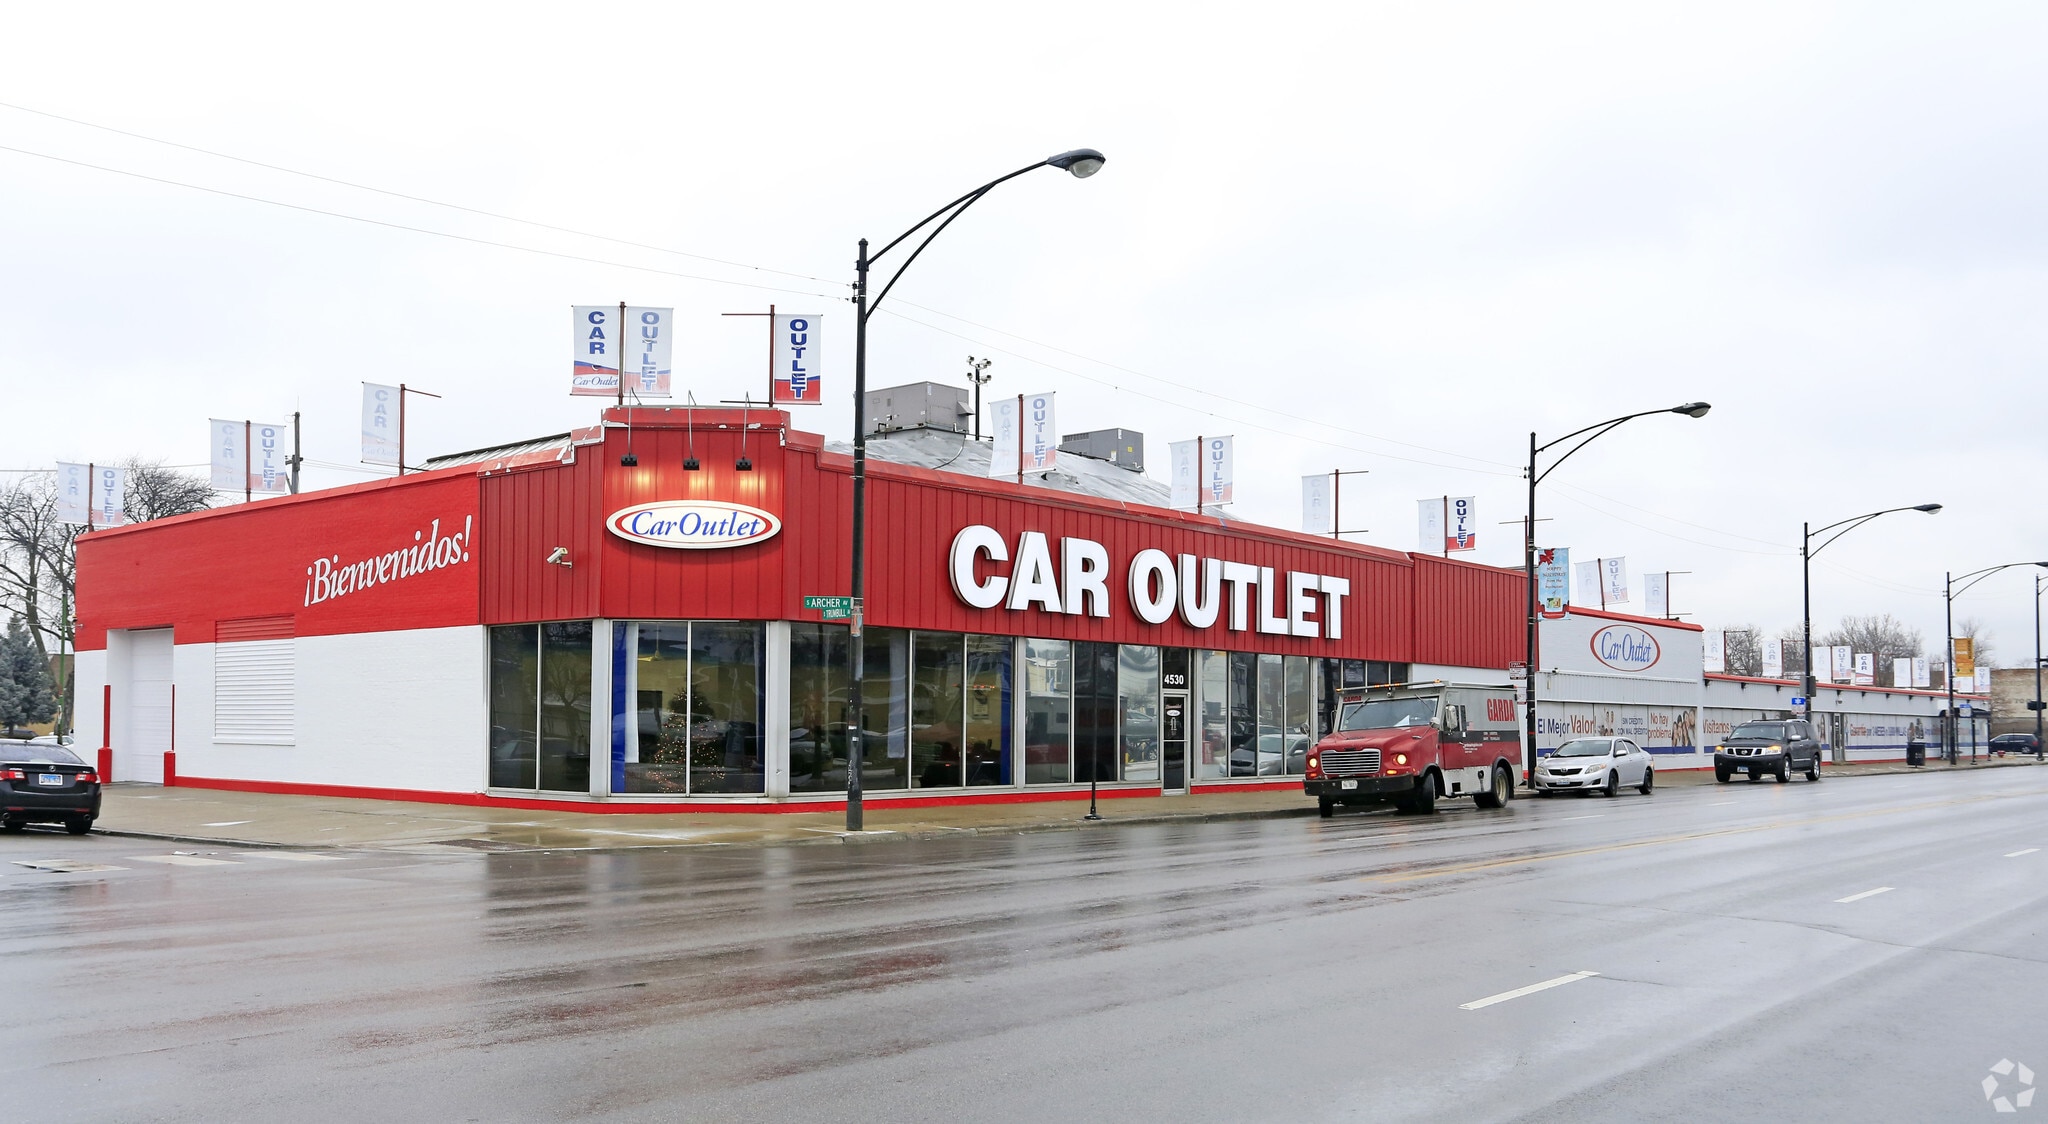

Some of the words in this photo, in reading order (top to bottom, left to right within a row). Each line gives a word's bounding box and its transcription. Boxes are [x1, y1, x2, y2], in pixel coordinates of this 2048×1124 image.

[588, 311, 606, 354] CAR
[641, 312, 660, 391] OUTLET
[789, 318, 809, 398] OUTLET
[374, 389, 389, 428] CAR
[1032, 397, 1046, 467] OUTLET
[261, 427, 275, 490] OUTLET
[1211, 440, 1224, 501] OUTLET
[103, 470, 116, 523] OUTLET
[1455, 499, 1467, 548] OUTLET
[304, 514, 473, 608] ¡Bienvenidos!
[949, 524, 1111, 618] CAR
[1128, 548, 1350, 640] OUTLET
[1609, 559, 1619, 600] OUTLET
[811, 597, 841, 608] ARCHER
[826, 608, 847, 618] TRUMBULL
[1164, 674, 1185, 685] 4530
[1487, 698, 1516, 722] GARDA
[1537, 718, 1547, 735] El
[1548, 718, 1570, 737] Mejor
[1650, 711, 1657, 725] No
[1658, 713, 1669, 727] hay
[1648, 724, 1672, 740] problema
